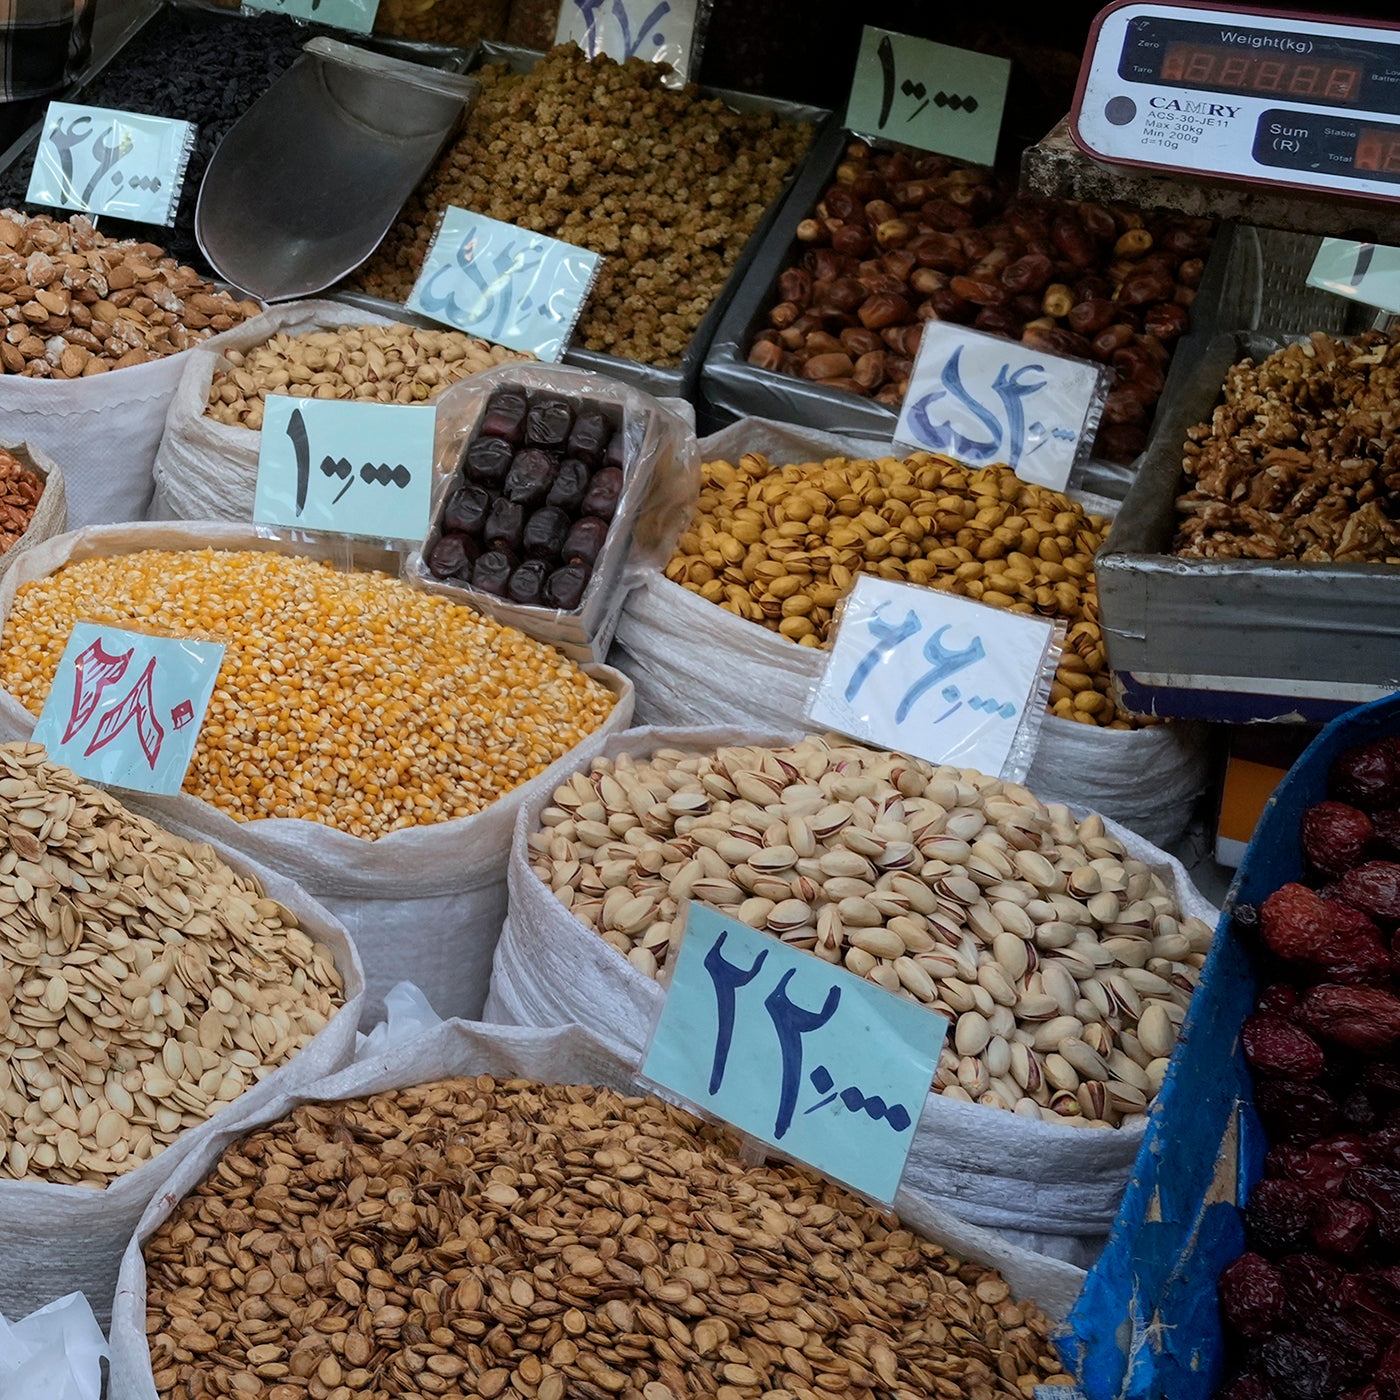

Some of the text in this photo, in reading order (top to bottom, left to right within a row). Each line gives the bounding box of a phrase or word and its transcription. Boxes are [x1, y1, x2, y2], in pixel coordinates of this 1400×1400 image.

[1137, 39, 1159, 49] Zero
[1220, 30, 1313, 54] Weight(kg)
[1133, 65, 1153, 74] Tare
[1149, 96, 1242, 119] CAMRY
[1147, 110, 1229, 128] ACS-30-JE11
[1145, 119, 1204, 135] Max 30kg
[1270, 123, 1309, 138] Sum
[1324, 127, 1356, 138] Stable
[1141, 137, 1179, 150] d=10g
[1143, 128, 1199, 145] Min 200g
[1273, 138, 1300, 153] (R)
[1328, 153, 1352, 163] Total
